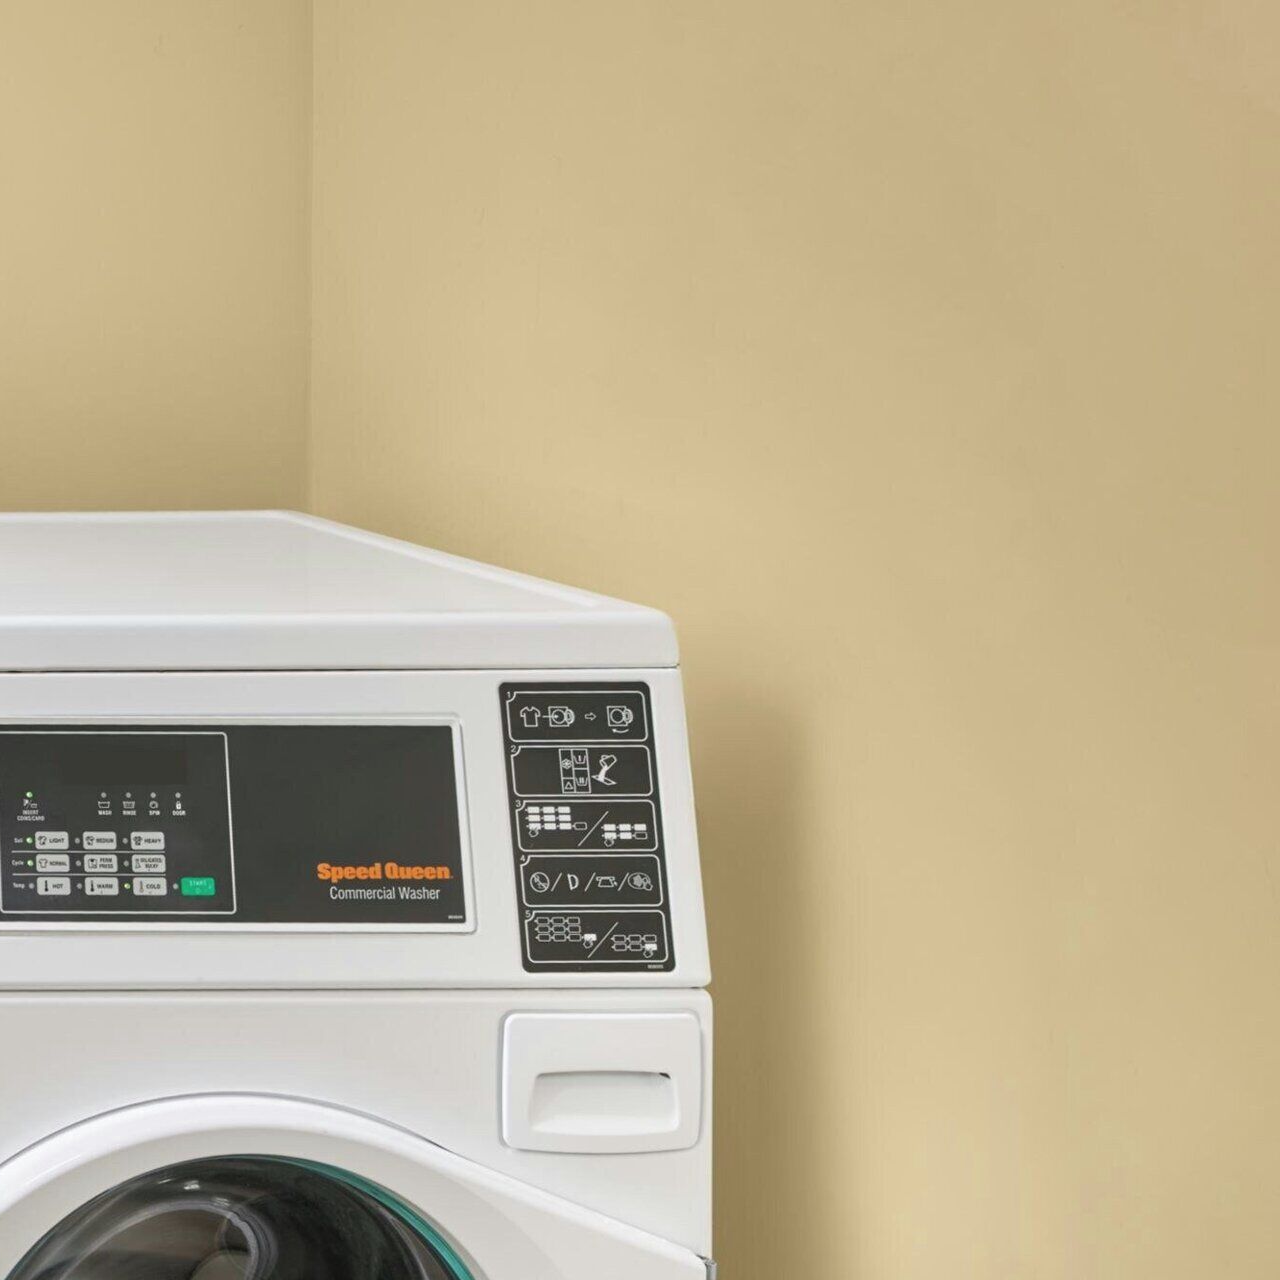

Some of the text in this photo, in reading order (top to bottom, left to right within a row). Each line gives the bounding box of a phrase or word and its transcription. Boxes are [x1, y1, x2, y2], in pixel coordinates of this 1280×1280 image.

[506, 691, 511, 699] 1
[317, 862, 451, 883] Speed Queen
[329, 886, 440, 900] Commercial Washer
[525, 910, 531, 918] 5
